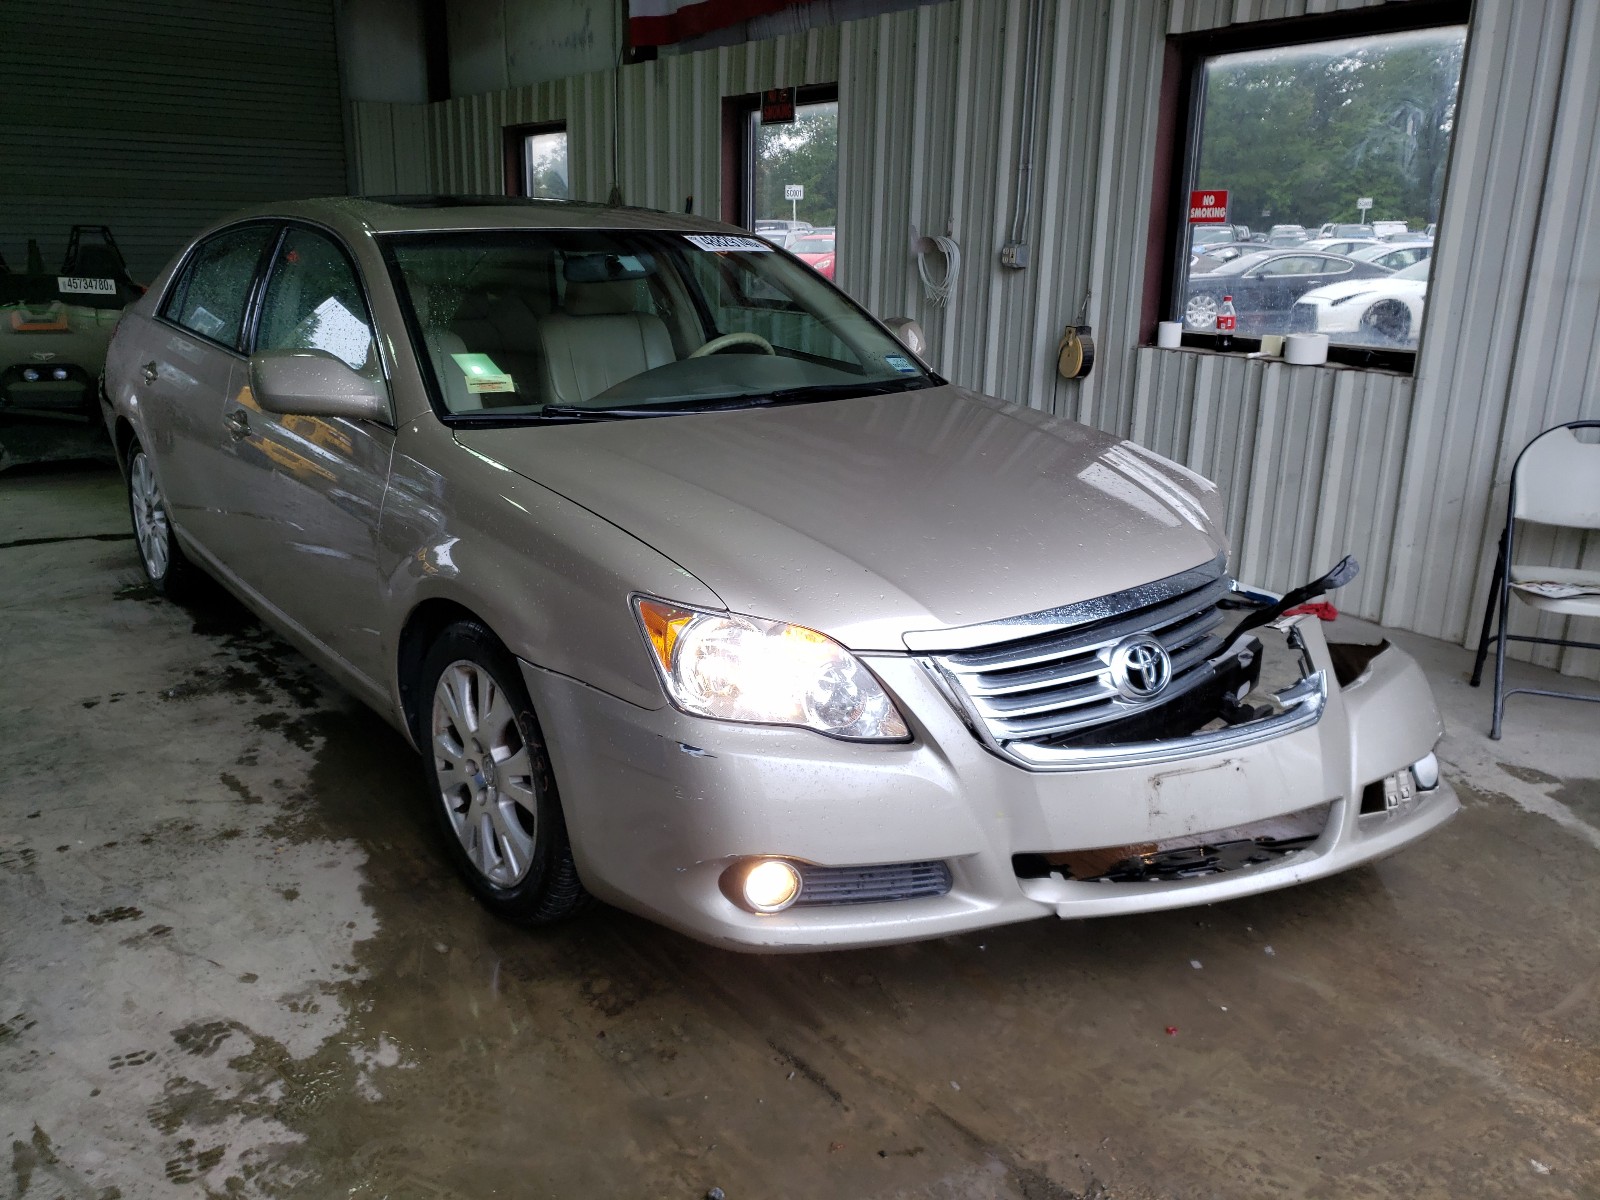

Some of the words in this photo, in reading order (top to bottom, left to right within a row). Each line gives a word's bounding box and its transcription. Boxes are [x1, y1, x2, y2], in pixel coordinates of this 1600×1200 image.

[1202, 194, 1215, 206] NO
[1190, 206, 1226, 218] SMOKING
[67, 277, 109, 291] 45734780
